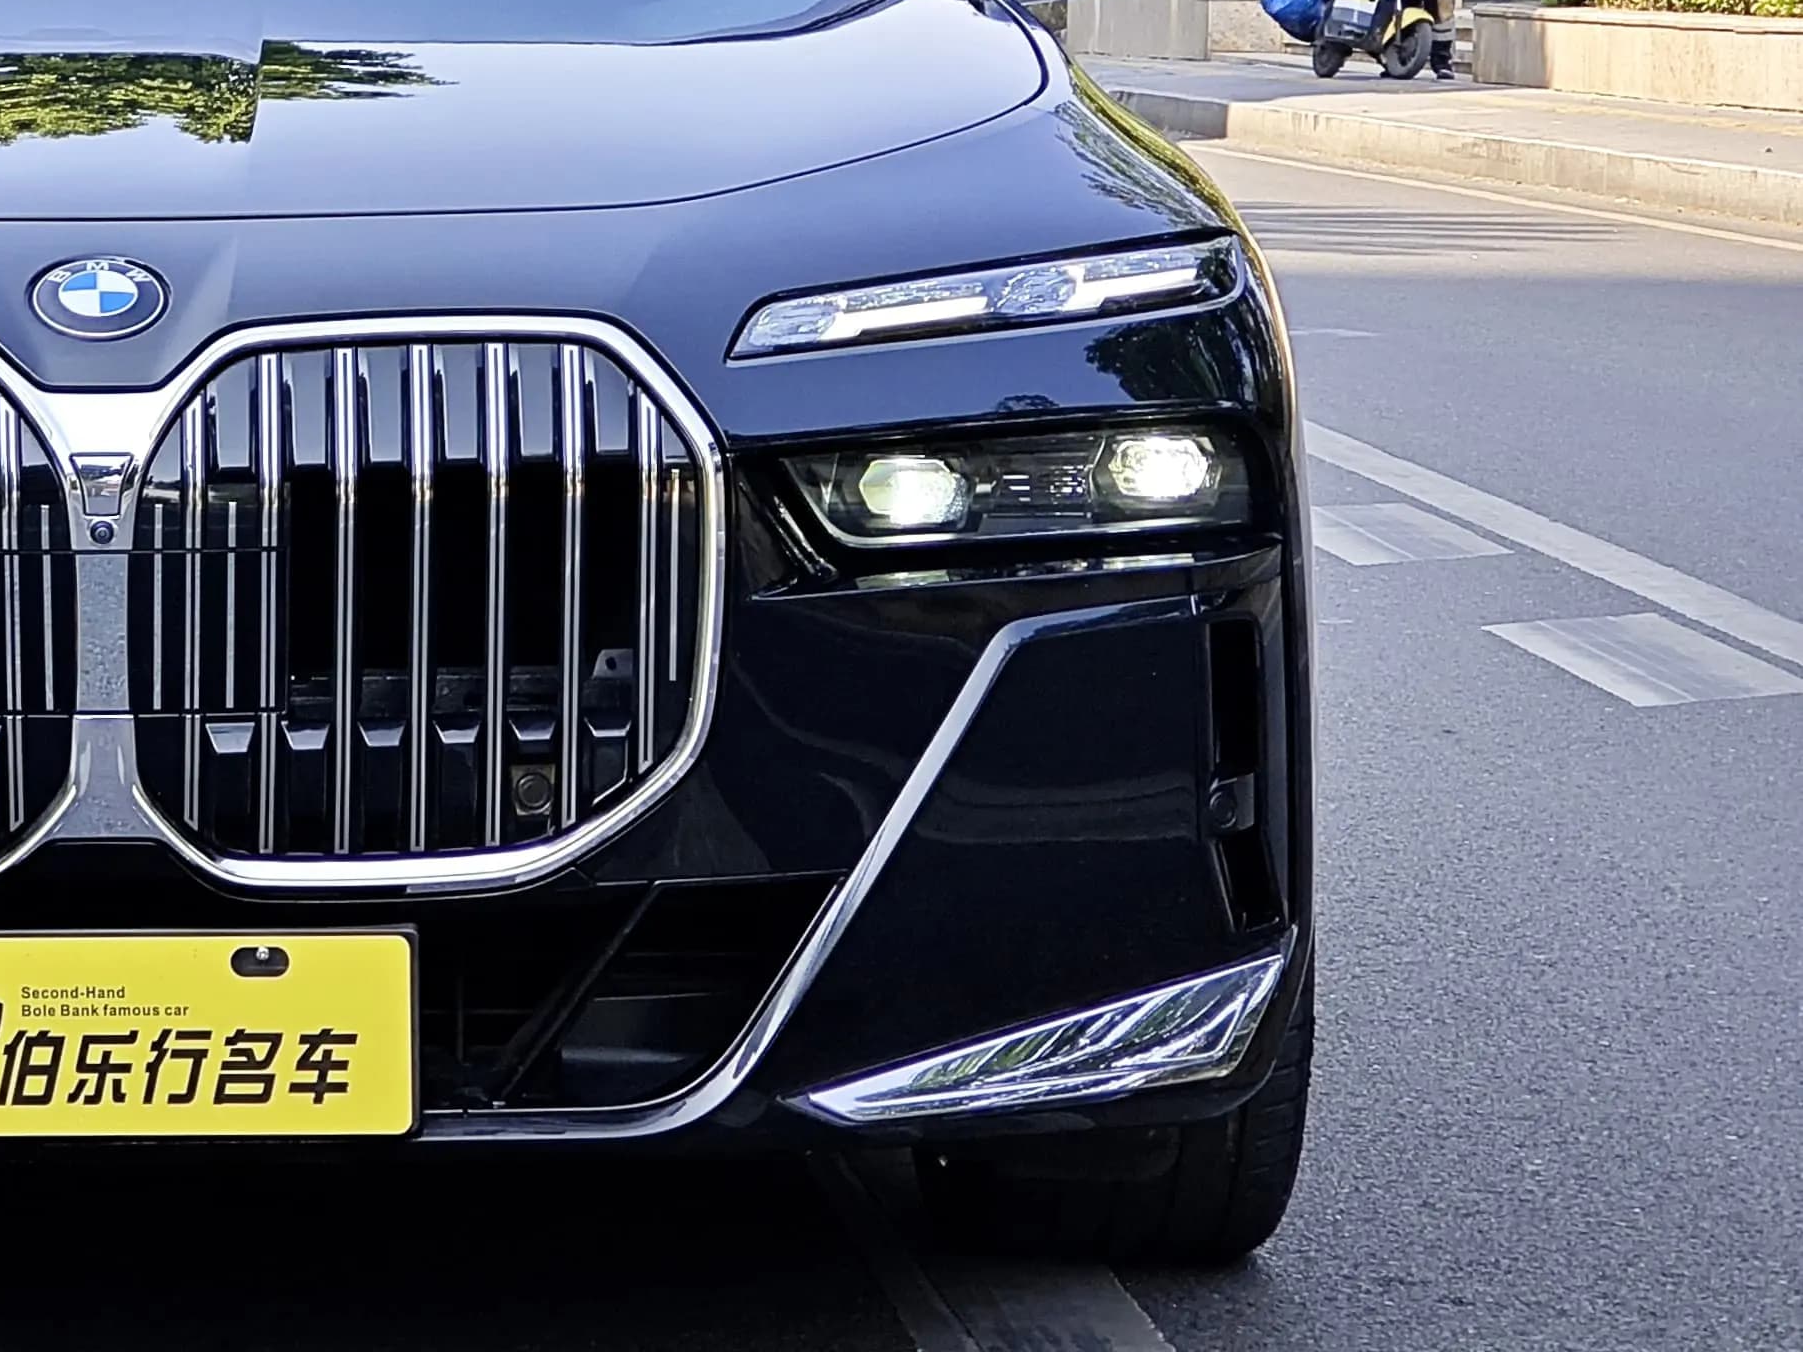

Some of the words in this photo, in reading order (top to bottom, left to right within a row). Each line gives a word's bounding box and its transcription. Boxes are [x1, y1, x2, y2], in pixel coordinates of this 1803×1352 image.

[47, 261, 152, 283] BMW
[20, 986, 126, 999] Second-Hand
[21, 1004, 56, 1017] Bole
[60, 1004, 99, 1017] Bank
[102, 1004, 160, 1017] famous
[164, 1006, 190, 1017] car
